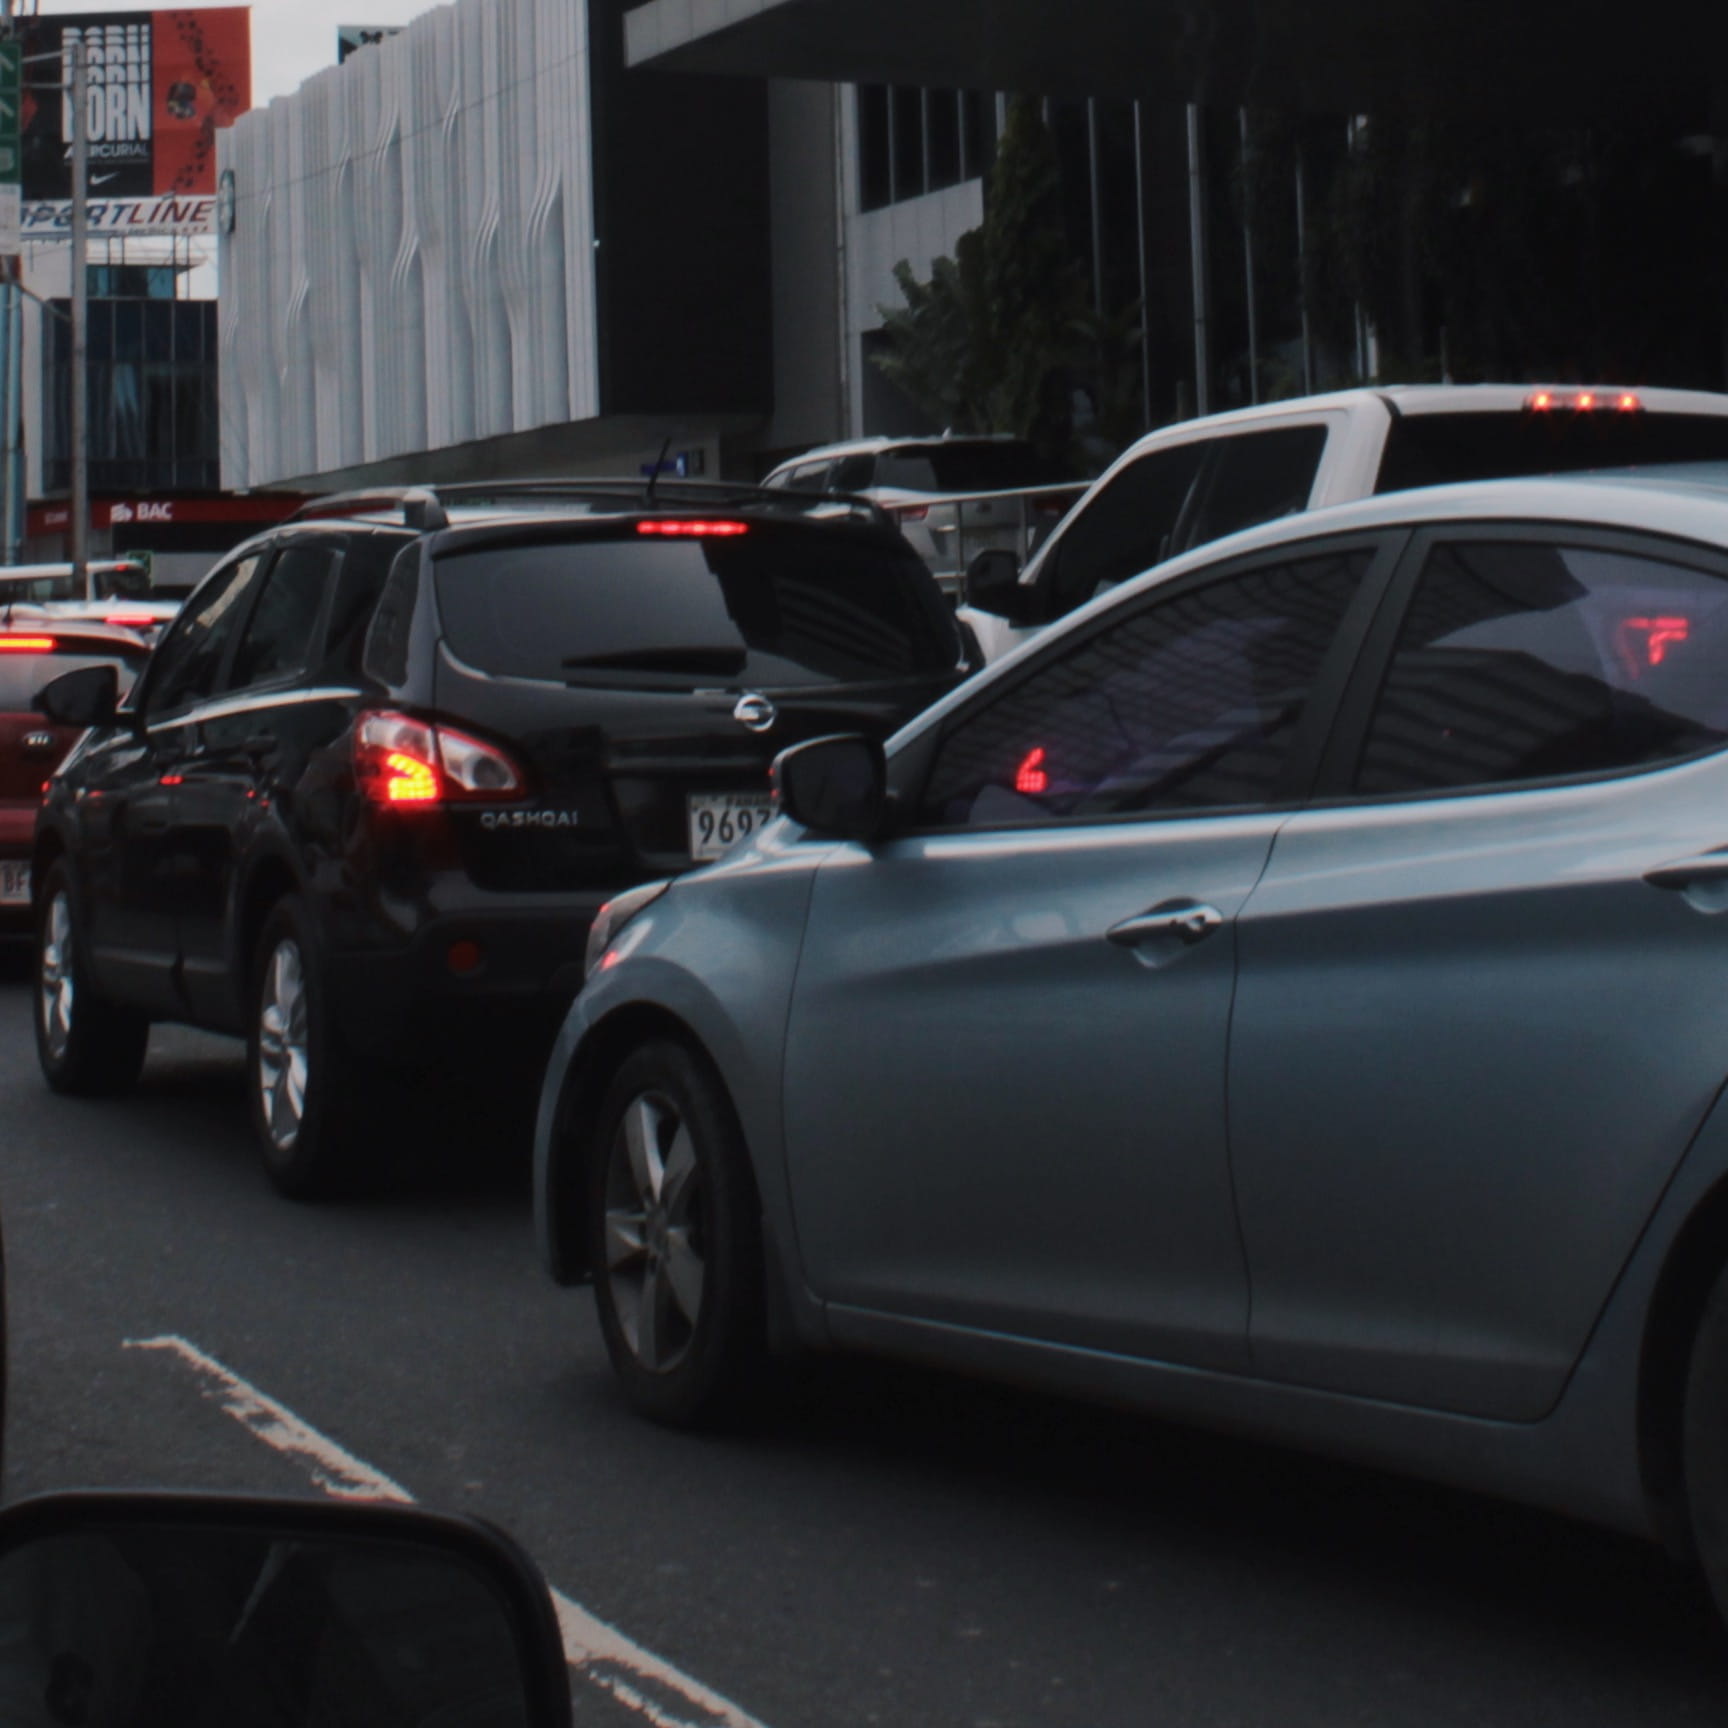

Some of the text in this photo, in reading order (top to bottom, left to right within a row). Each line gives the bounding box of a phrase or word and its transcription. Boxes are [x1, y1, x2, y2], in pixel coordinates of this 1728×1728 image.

[22, 200, 216, 227] PORTLINE
[136, 502, 173, 520] BAC
[479, 808, 579, 829] QASHQAI
